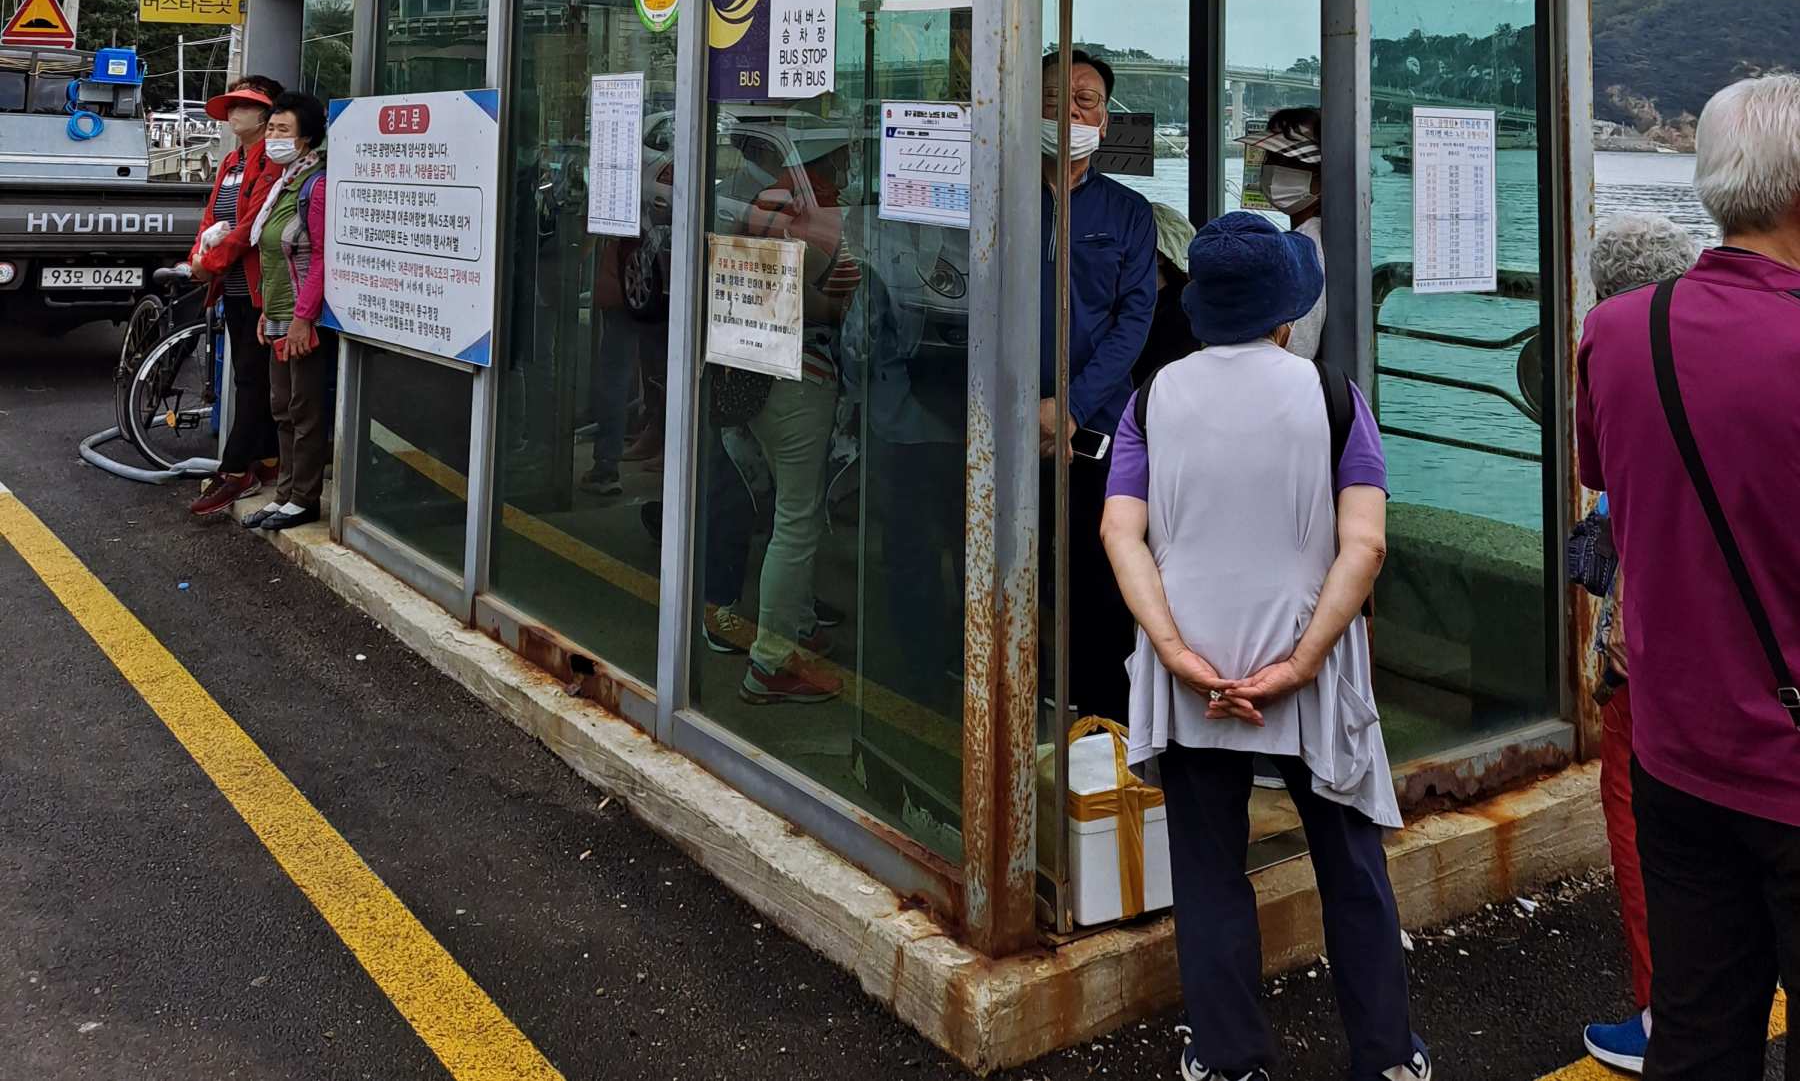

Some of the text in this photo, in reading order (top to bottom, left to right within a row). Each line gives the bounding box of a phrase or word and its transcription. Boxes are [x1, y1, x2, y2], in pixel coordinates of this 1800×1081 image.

[782, 8, 826, 25] 시내버스
[781, 26, 826, 44] 승차장
[779, 49, 828, 65] BUS STOP
[739, 70, 761, 87] BUS
[806, 70, 827, 87] BUS
[387, 108, 420, 131] 경고문
[27, 212, 175, 233] HYUNDAI
[51, 269, 134, 285] 93모 0642
